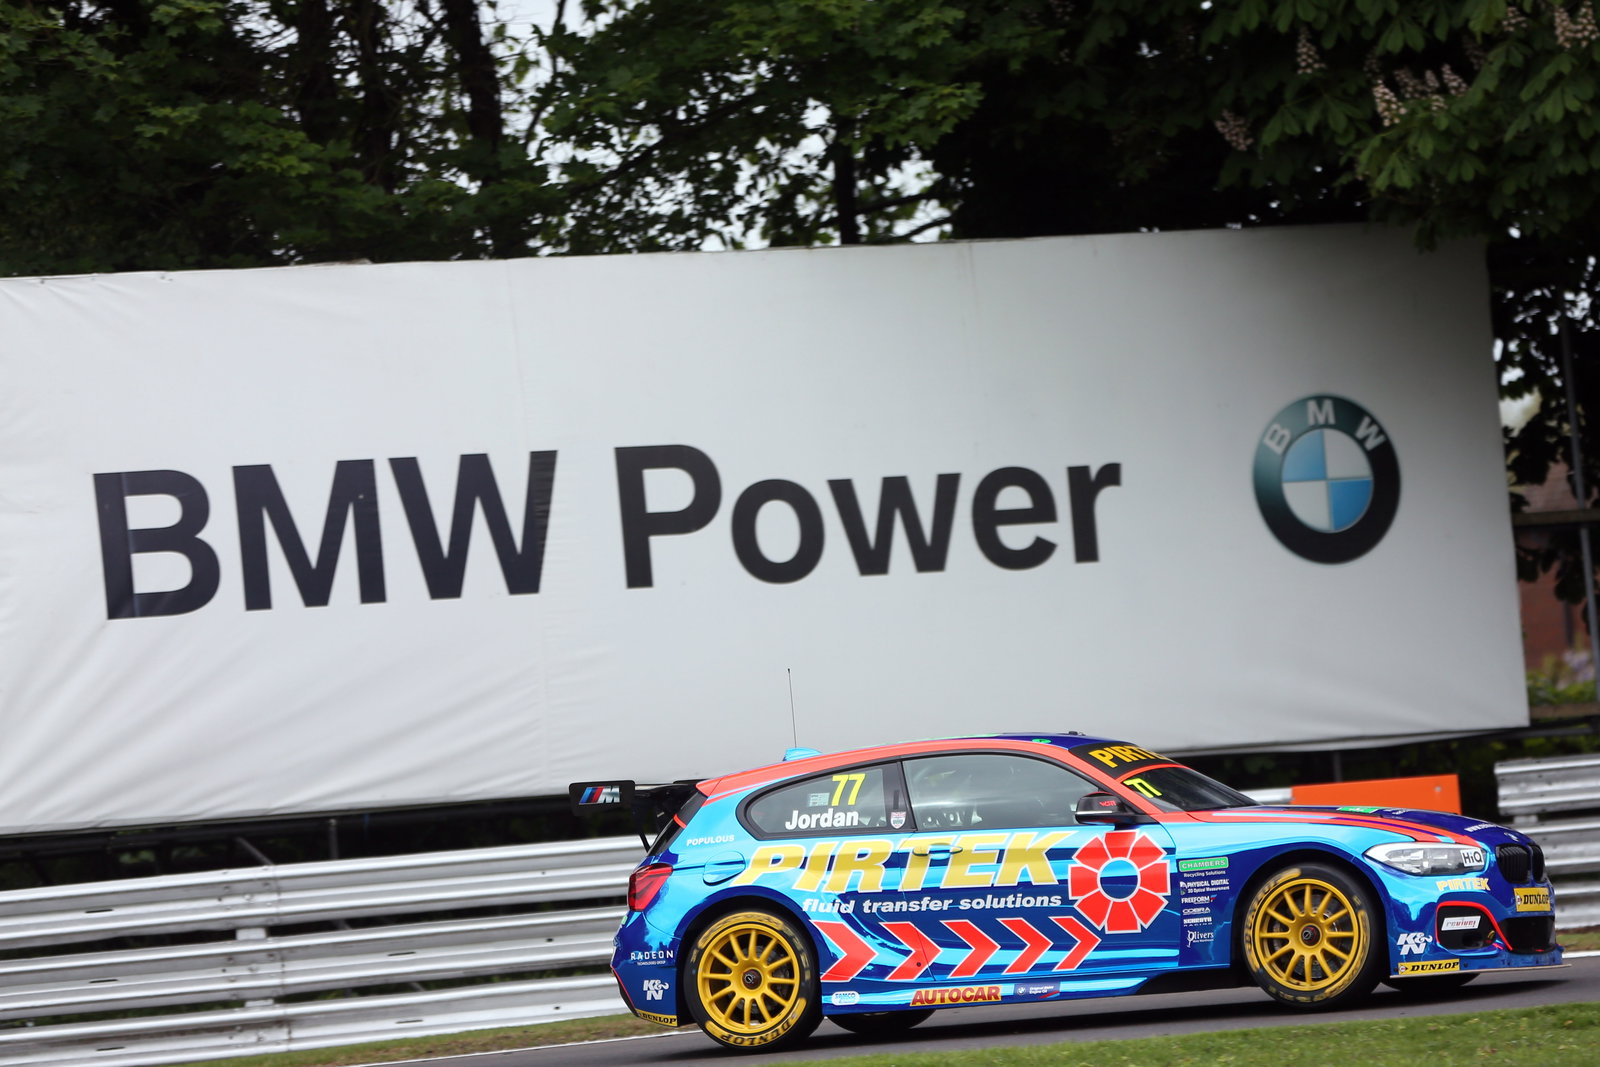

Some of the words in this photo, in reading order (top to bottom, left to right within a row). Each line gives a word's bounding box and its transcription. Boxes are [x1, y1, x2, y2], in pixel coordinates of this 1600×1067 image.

[1263, 399, 1387, 455] BMW
[93, 450, 558, 620] BMW
[614, 444, 1122, 588] Power
[1088, 745, 1168, 768] PIRT
[831, 773, 866, 806] 77
[785, 808, 860, 830] Jordan
[686, 834, 735, 847] POPULOUS
[729, 830, 1078, 895] PIRTEK
[1182, 860, 1226, 869] CHAMBERS
[1462, 851, 1483, 864] HiQ
[1436, 878, 1491, 891] PIRTEK
[802, 898, 855, 914] fluid
[862, 897, 953, 913] transfer
[959, 893, 1062, 910] solutions
[1396, 932, 1433, 956] K&N
[630, 950, 674, 961] RADEON
[1410, 962, 1460, 972] DUNLOP
[643, 979, 670, 1001] K&N
[911, 986, 1001, 1005] AUTOCAR
[641, 1013, 678, 1025] DUNLOP
[720, 1020, 792, 1046] DUNLOP
